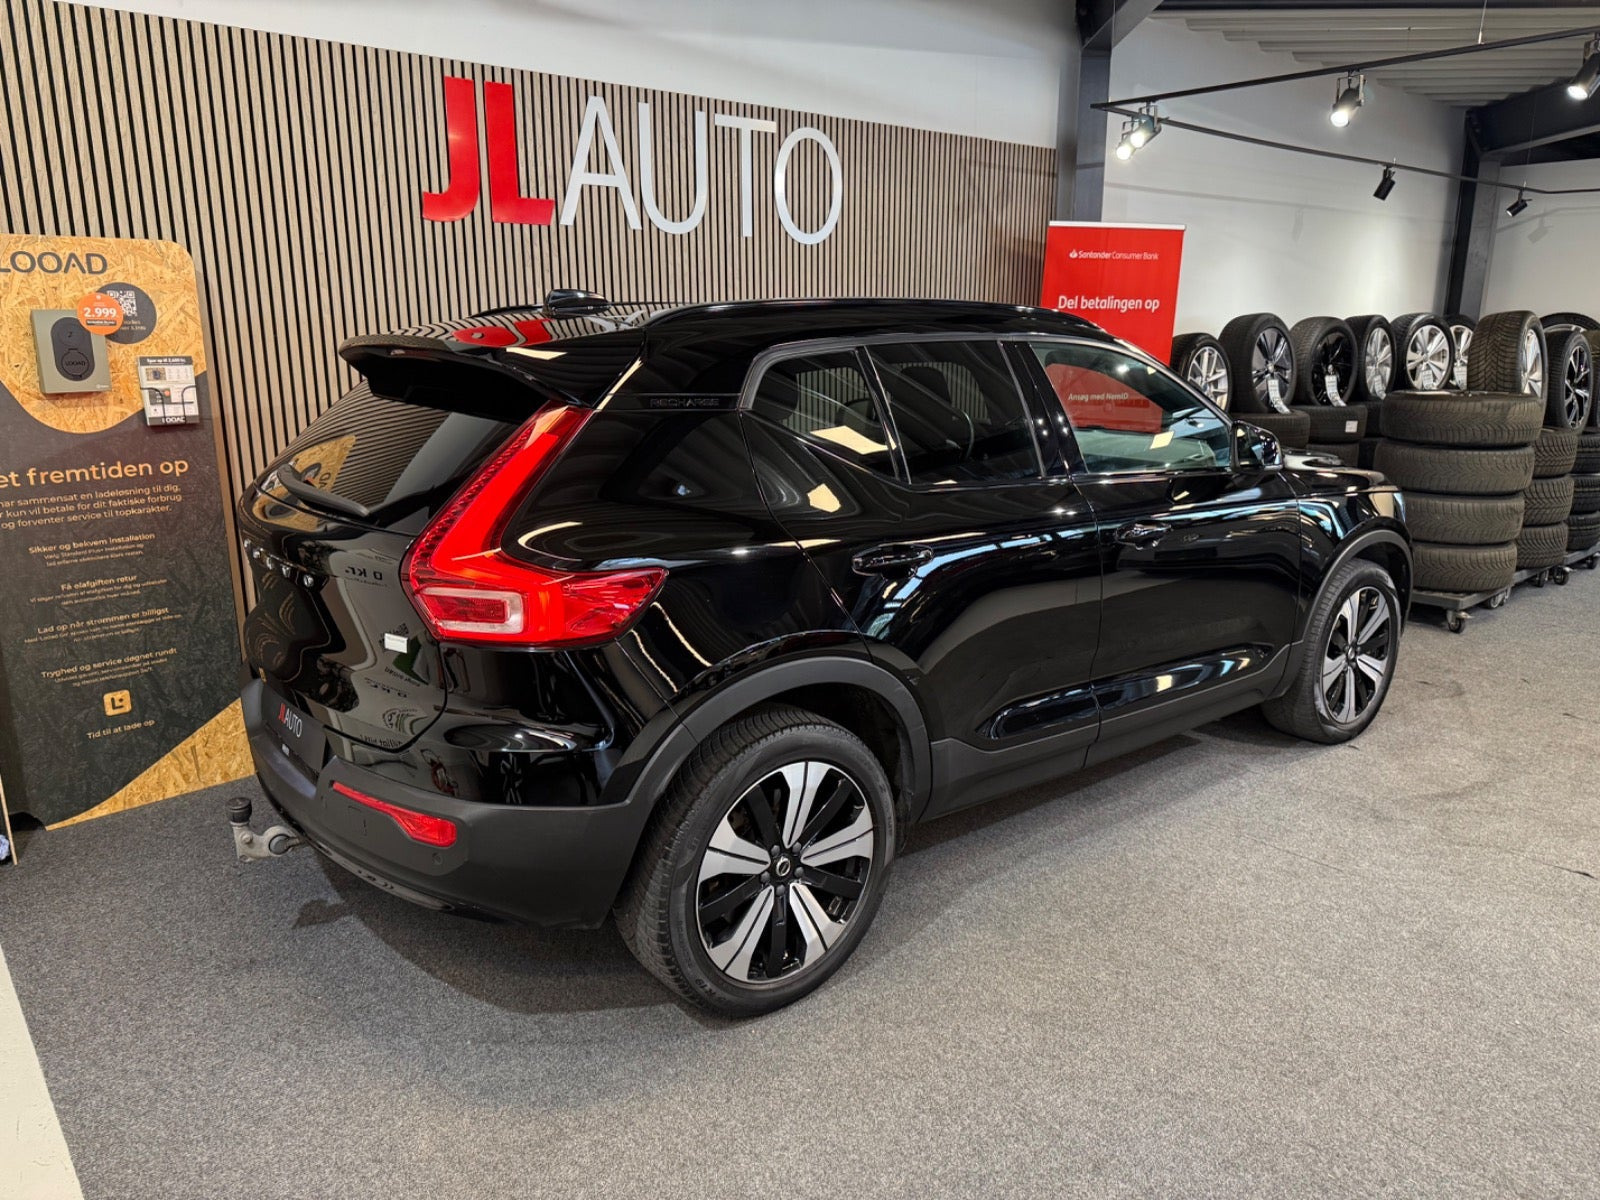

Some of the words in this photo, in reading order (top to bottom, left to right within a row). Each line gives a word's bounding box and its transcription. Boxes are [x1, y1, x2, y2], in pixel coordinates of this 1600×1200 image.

[1078, 250, 1112, 259] Santander
[1112, 251, 1142, 260] Consumer
[1143, 251, 1159, 260] Bank
[1058, 295, 1079, 309] Del
[1080, 295, 1142, 314] betalingen
[1144, 299, 1160, 313] op
[1068, 393, 1088, 402] Ansøg
[1090, 392, 1104, 400] med
[27, 461, 153, 486] fremtiden
[160, 460, 189, 477] op
[17, 493, 78, 506] sammensat
[80, 492, 93, 500] en
[152, 485, 162, 493] til
[6, 510, 27, 518] kun
[29, 507, 41, 515] vil
[43, 504, 75, 514] betale
[77, 502, 92, 511] for
[93, 500, 106, 509] dit
[108, 497, 145, 507] faktiske
[147, 494, 182, 503] forbrug
[1, 521, 15, 529] og
[18, 515, 65, 527] forventer
[67, 512, 101, 521] service
[103, 510, 114, 518] til
[28, 545, 57, 554] Sikker
[59, 543, 72, 551] og
[72, 539, 107, 549] bekvem
[37, 625, 55, 634] Lad
[70, 620, 84, 629] når
[141, 607, 169, 616] billigst
[41, 665, 78, 678] Tryghed
[92, 658, 122, 669] service
[155, 647, 177, 657] rundt
[86, 729, 101, 739] Tid
[103, 727, 112, 736] til
[113, 725, 122, 733] at
[124, 722, 142, 731] lade
[143, 719, 156, 727] op
